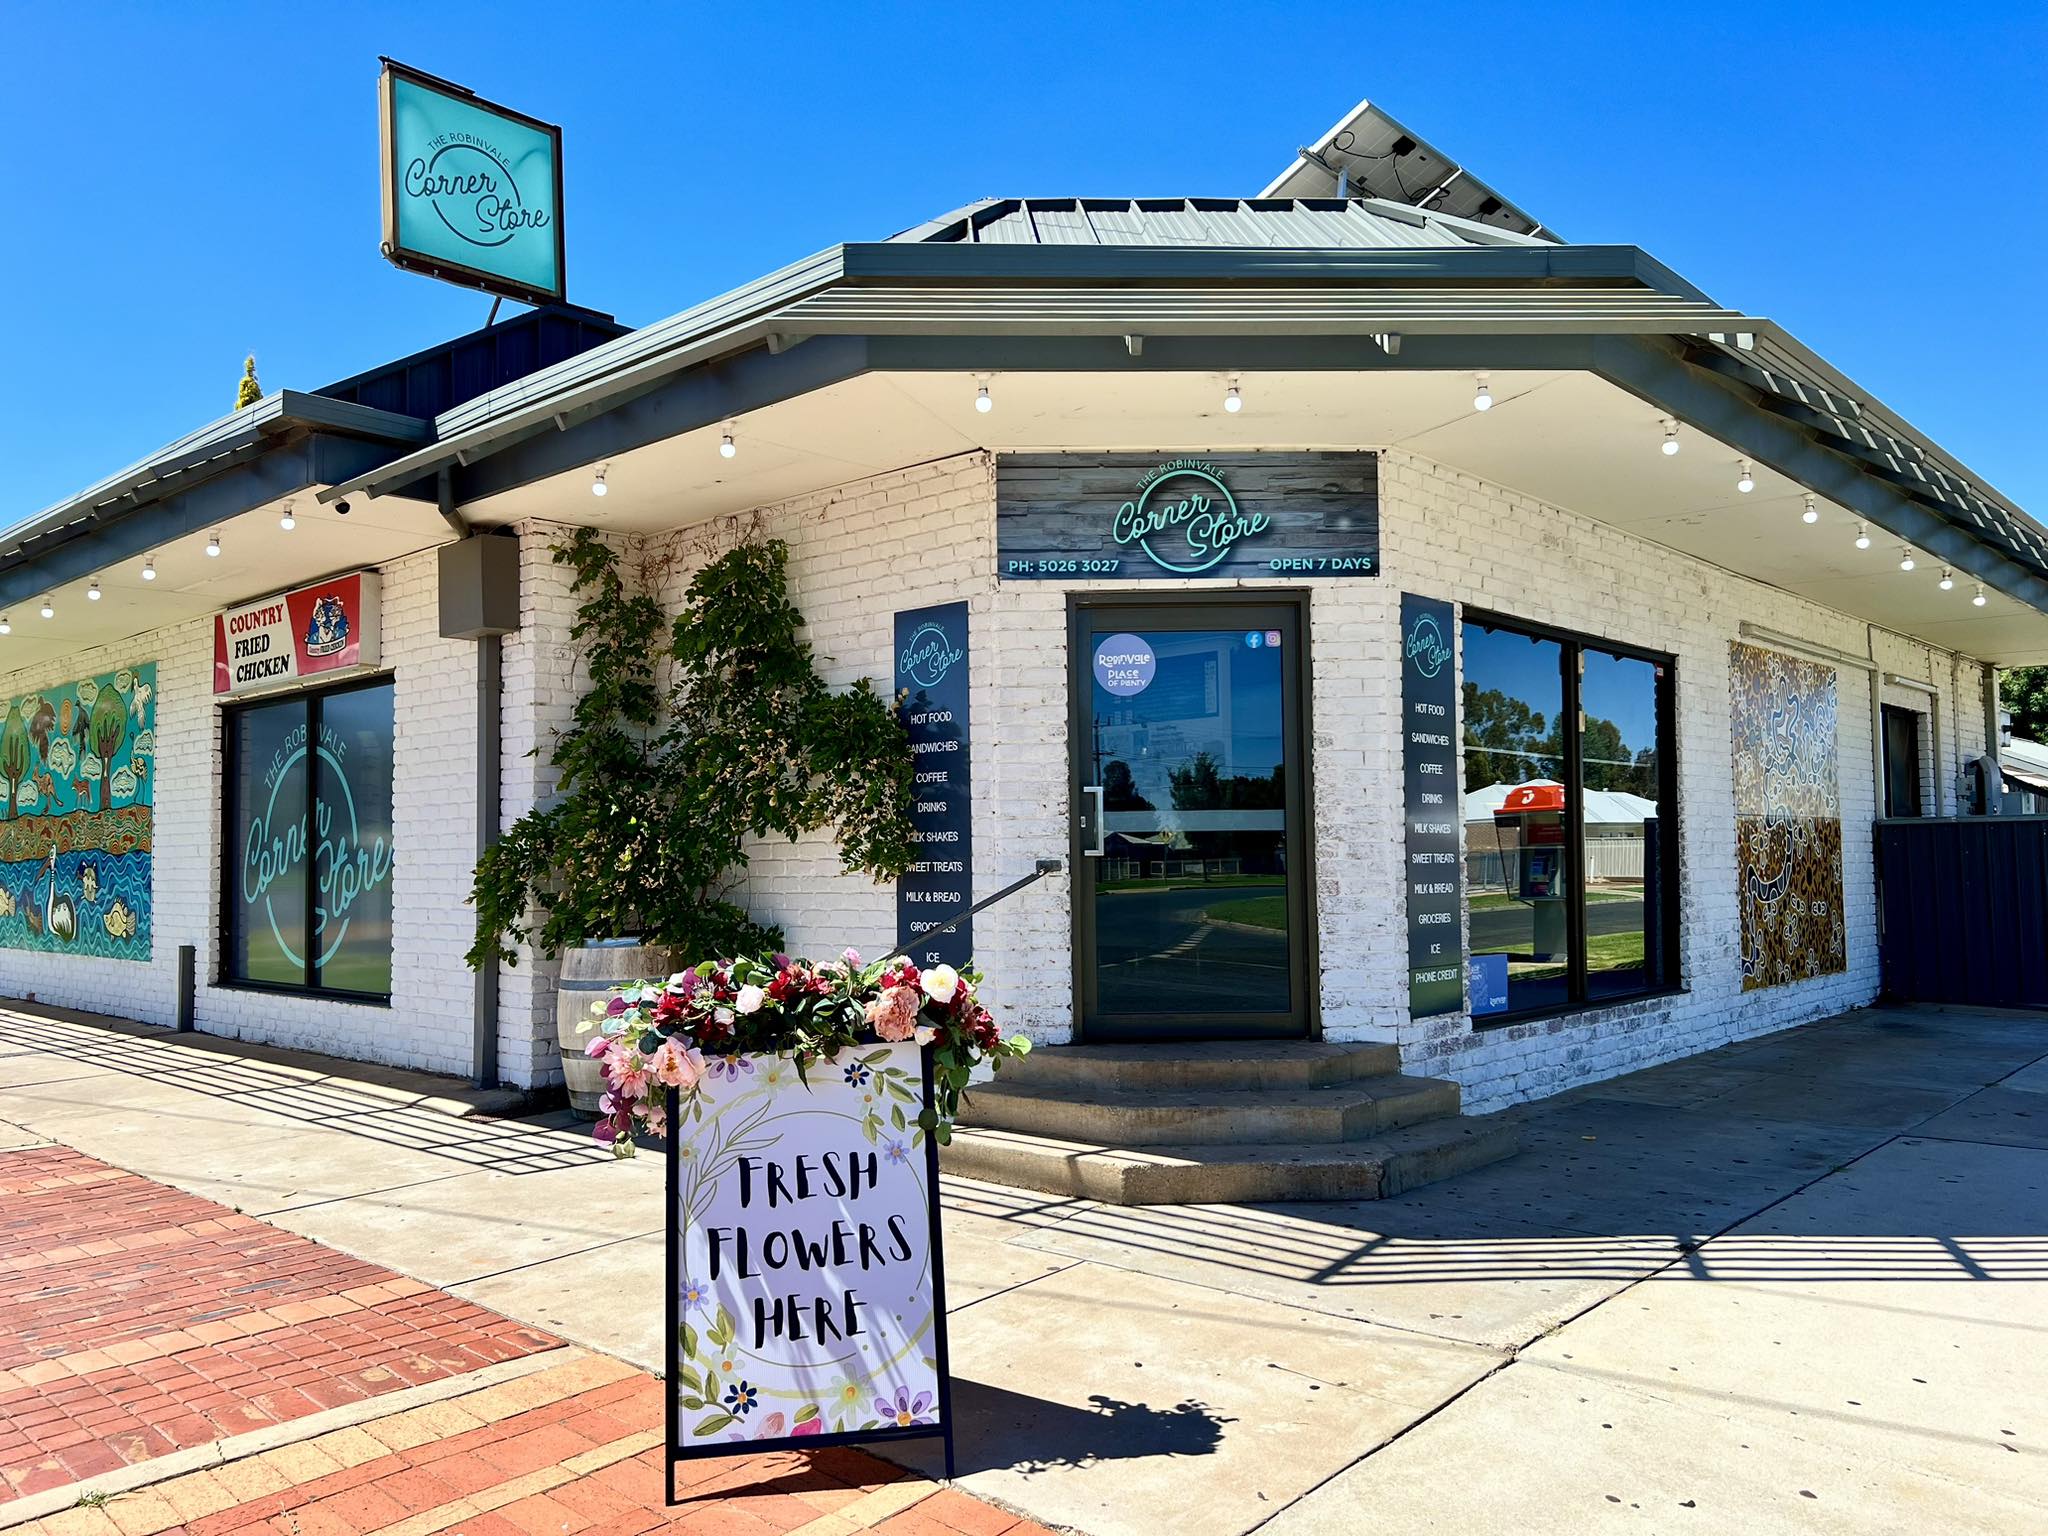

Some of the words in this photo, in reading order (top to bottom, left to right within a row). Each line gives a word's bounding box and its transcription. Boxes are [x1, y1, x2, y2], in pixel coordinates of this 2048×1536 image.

[428, 134, 446, 151] THE
[450, 132, 510, 167] ROBINVALE
[405, 158, 497, 197] Corner
[476, 194, 550, 232] Store
[1136, 470, 1157, 490] THE
[1158, 459, 1226, 480] ROBINVALE
[1113, 494, 1209, 545] Corner
[1187, 511, 1270, 557] Store
[1009, 560, 1034, 572] PH:
[1039, 560, 1078, 572] 5026
[1081, 560, 1119, 572] 3027
[1270, 558, 1314, 571] OPEN
[1318, 558, 1327, 570] 7
[1331, 558, 1371, 570] DAYS
[230, 604, 284, 635] COUNTRY
[234, 633, 270, 660] FRIED
[1406, 632, 1436, 658] Corner
[900, 641, 938, 674] Corner
[928, 648, 963, 678] Store
[1427, 644, 1452, 670] Store
[236, 654, 291, 683] CHICKEN
[1415, 702, 1427, 714] HOT
[1428, 703, 1445, 716] FOOD
[910, 713, 926, 725] HOT
[928, 711, 952, 723] FOOD
[1411, 731, 1449, 746] SANDWICHES
[264, 749, 284, 789] THE
[285, 722, 347, 763] ROBVALE
[1420, 763, 1443, 775] COFFEE
[916, 771, 948, 783] COFFEE
[1421, 793, 1443, 804] DRINKS
[918, 802, 947, 813] DRINKS
[1414, 823, 1428, 834] MILK
[1429, 823, 1451, 834] SHAKES
[926, 831, 959, 842] SHAKES
[1411, 853, 1432, 864] SWEET
[1433, 853, 1455, 864] TREATS
[932, 861, 963, 872] TREATS
[1414, 883, 1428, 894] MILK
[1429, 883, 1434, 894] &
[1434, 882, 1454, 894] BREAD
[906, 891, 924, 903] MILK
[925, 892, 932, 902] &
[933, 891, 961, 903] BREAD
[1418, 912, 1451, 925] GROCERIES
[1430, 943, 1441, 954] ICE
[926, 951, 940, 963] ICE
[1415, 971, 1437, 984] PHONE
[1437, 968, 1458, 981] CREDIT
[738, 1151, 878, 1209] FRESH
[707, 1214, 913, 1281] FLOWERS
[754, 1289, 868, 1349] HERE
